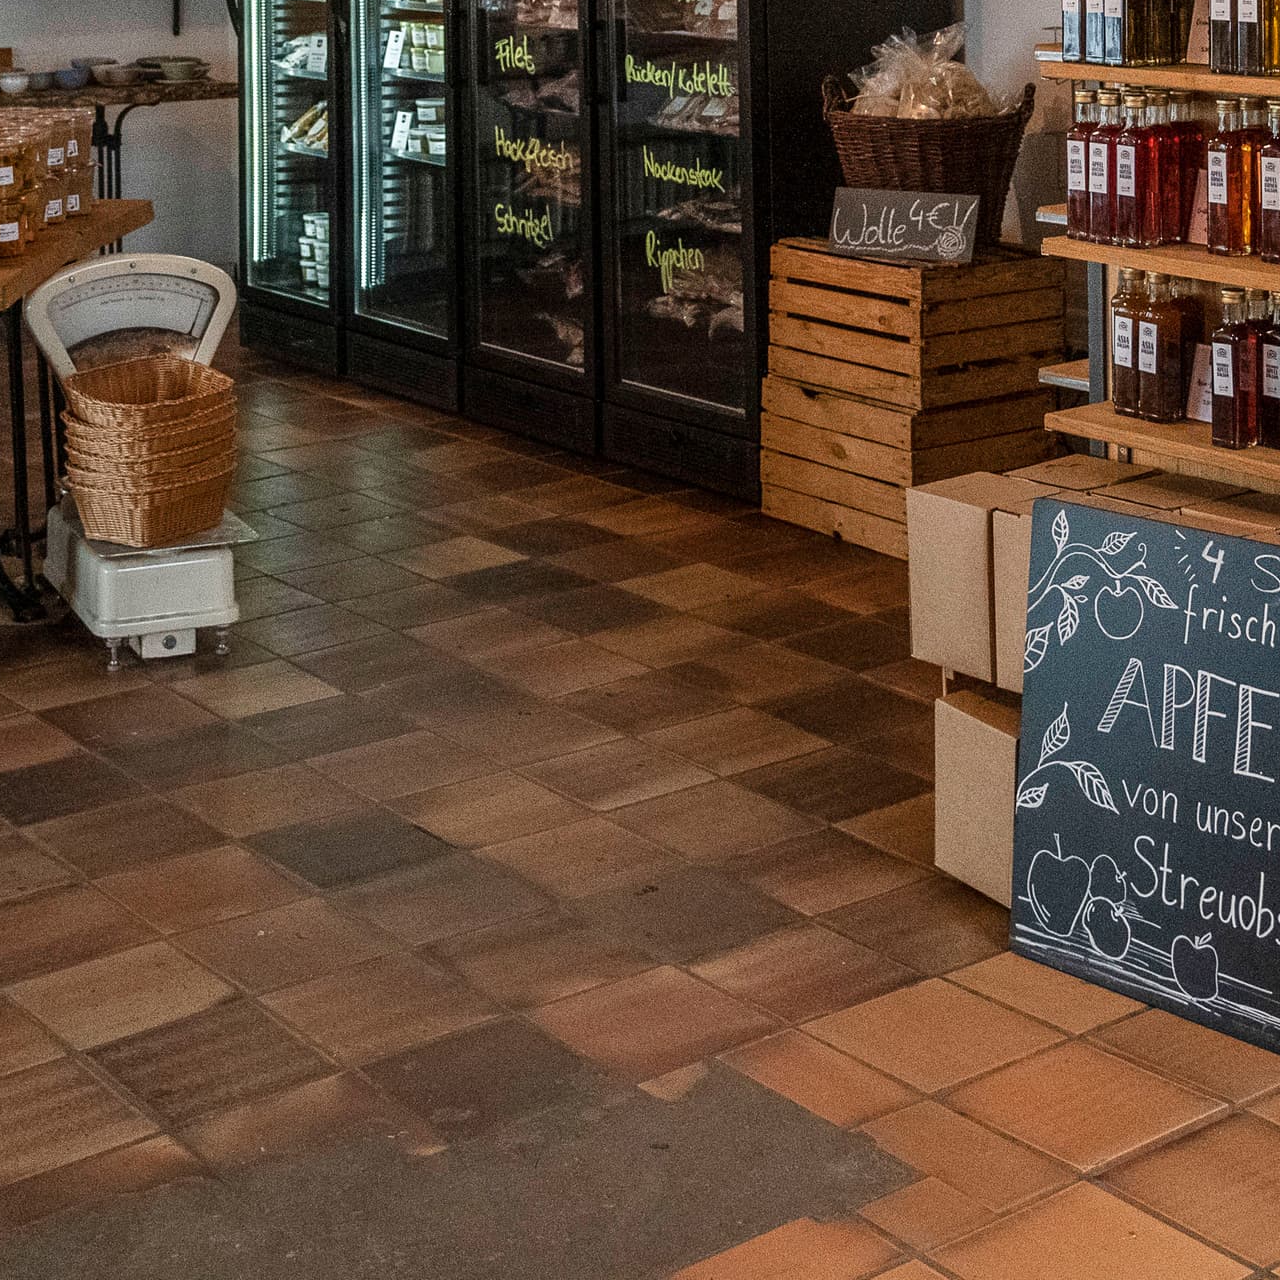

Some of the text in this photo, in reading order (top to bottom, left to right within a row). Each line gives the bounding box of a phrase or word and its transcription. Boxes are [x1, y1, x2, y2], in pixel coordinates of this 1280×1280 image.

[495, 35, 535, 75] Filet
[495, 125, 573, 173] Hackfleisch
[643, 145, 726, 193] Nackensteak
[495, 203, 554, 249] Schnitzel
[833, 203, 906, 245] Wolle
[645, 230, 705, 294] Rippchen
[1202, 539, 1226, 585] 4
[1182, 583, 1276, 647] frisch
[1122, 779, 1178, 825] von
